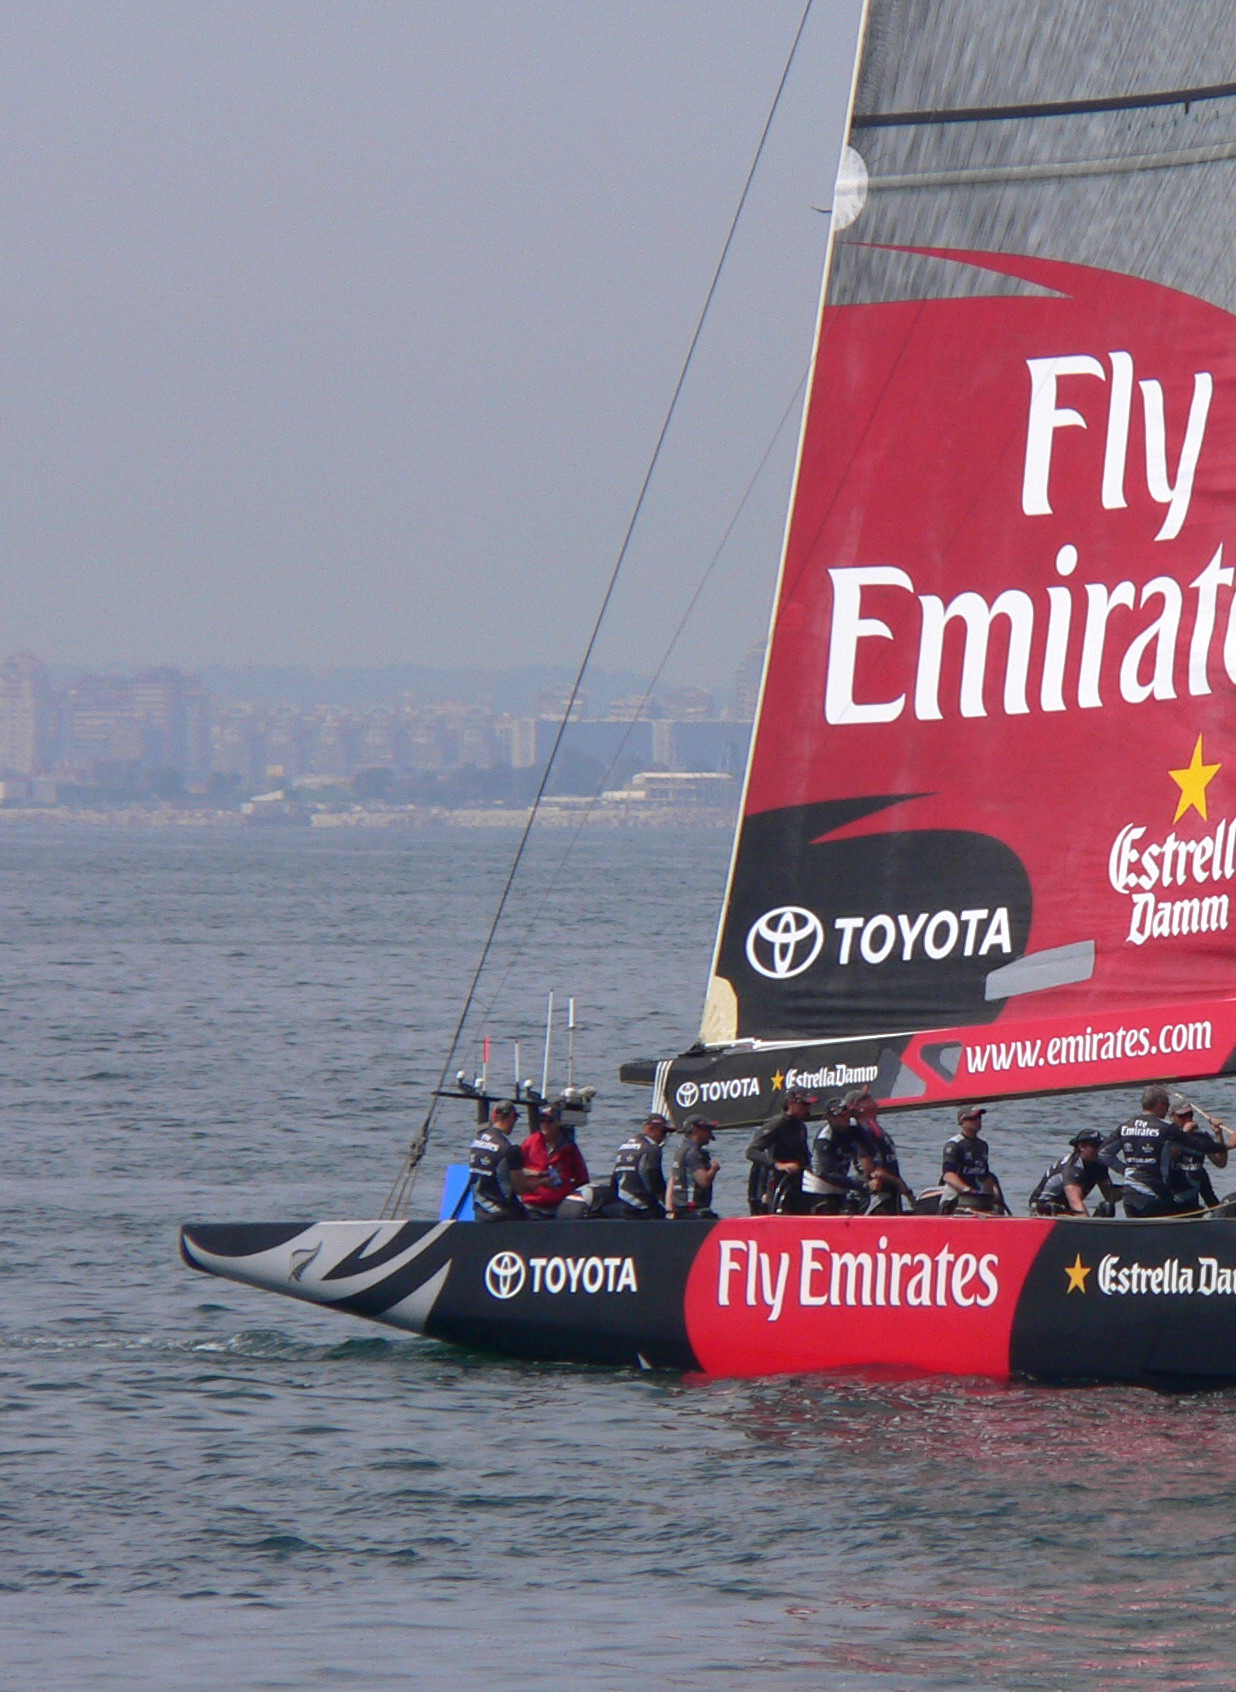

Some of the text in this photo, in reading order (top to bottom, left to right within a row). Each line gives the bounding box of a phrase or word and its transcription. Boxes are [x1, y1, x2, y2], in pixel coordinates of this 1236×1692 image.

[1022, 350, 1212, 541] Fly
[834, 907, 1013, 965] TOYOTA
[1126, 889, 1230, 946] Damm
[966, 1018, 1213, 1075] www.emirates.com
[700, 1077, 760, 1101] TOYOTA
[1121, 1125, 1160, 1137] Emirates
[530, 1256, 638, 1293] TOYOTA
[718, 1236, 999, 1322] Fly Emirates
[1098, 1253, 1195, 1296] Estrella
